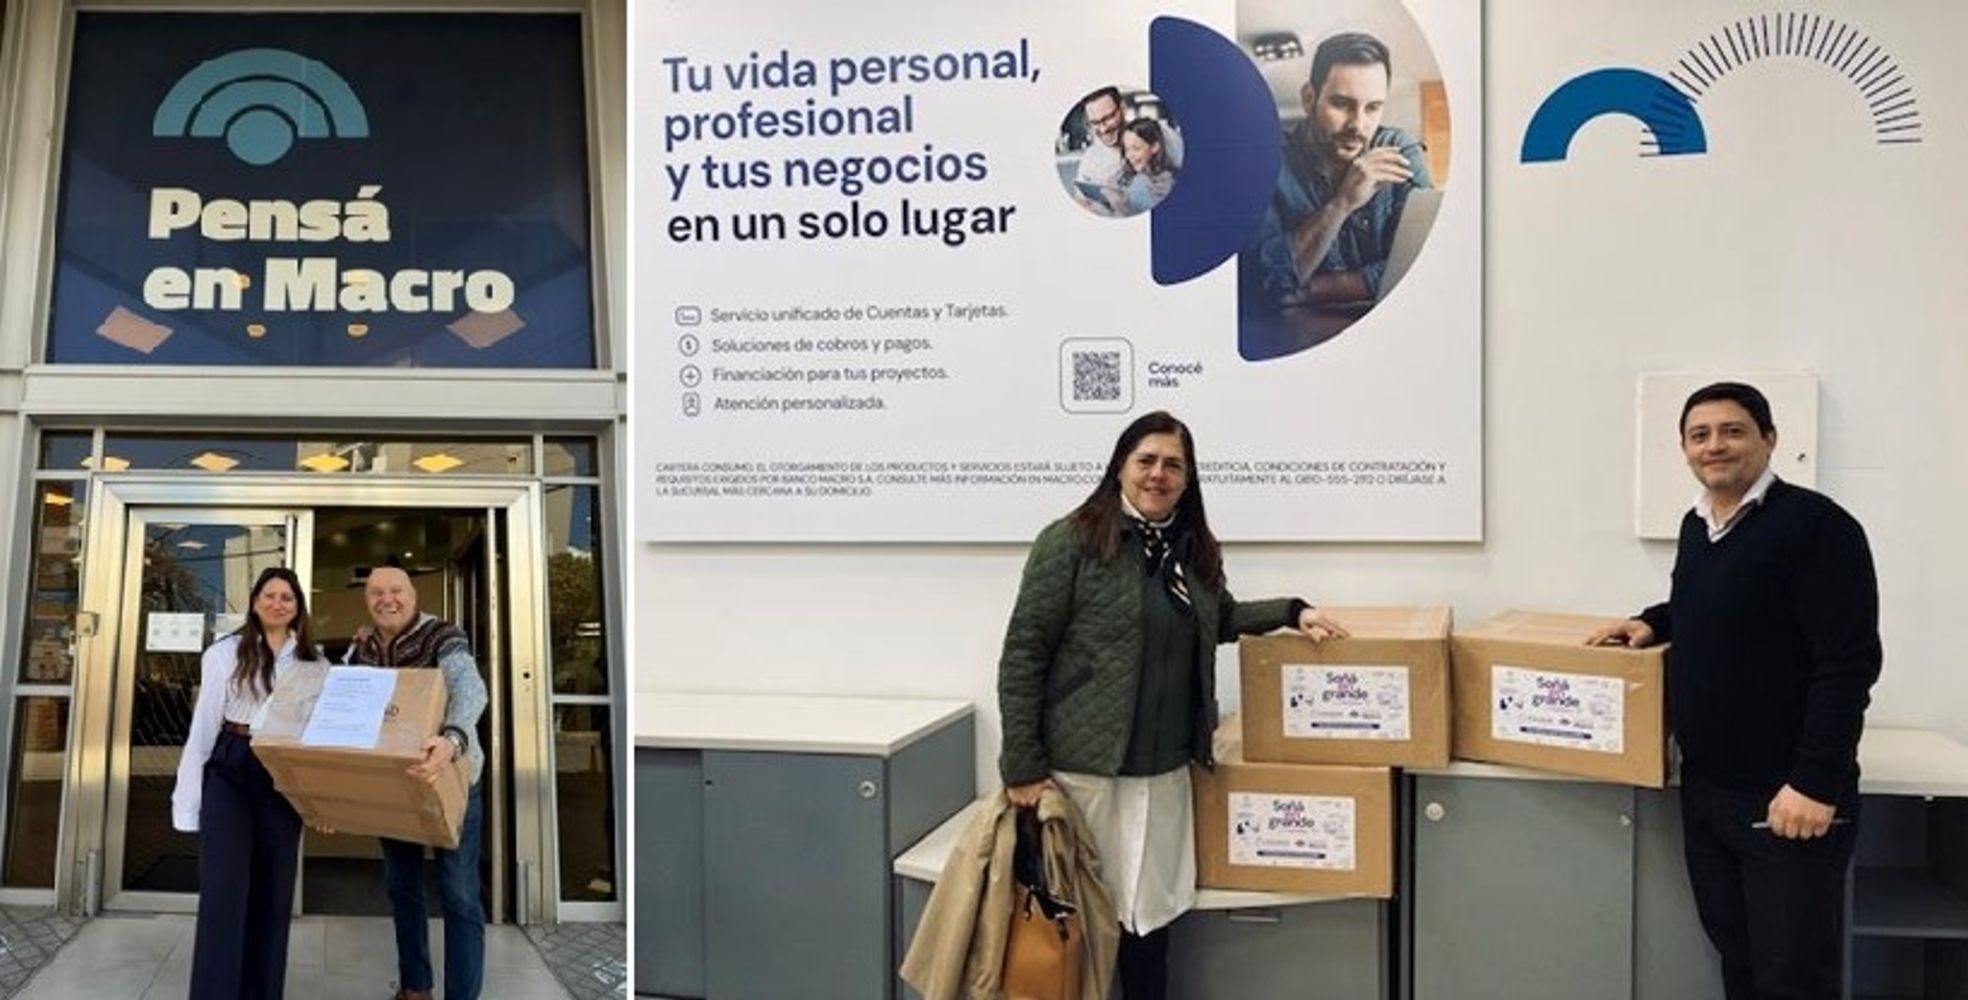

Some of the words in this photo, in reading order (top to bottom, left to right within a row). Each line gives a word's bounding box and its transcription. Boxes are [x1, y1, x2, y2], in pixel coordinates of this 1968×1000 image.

[662, 56, 712, 93] Tu
[724, 50, 817, 90] vida
[830, 38, 1041, 96] personal,
[664, 95, 913, 152] profesional
[666, 162, 691, 201] y
[702, 155, 772, 189] tus
[784, 144, 988, 196] negocios
[148, 185, 392, 242] Pensá
[667, 213, 719, 242] en
[732, 212, 786, 240] un
[798, 200, 888, 239] solo
[901, 198, 1016, 247] lugar
[143, 266, 244, 311] en
[263, 257, 515, 314] Macro
[711, 306, 769, 322] Servicio
[771, 305, 841, 321] unificado
[843, 306, 864, 321] de
[866, 304, 930, 320] Cuentas
[931, 307, 944, 321] y
[944, 302, 1009, 322] Tarjetas.
[712, 338, 791, 353] Soluciones
[794, 338, 814, 352] de
[816, 337, 868, 352] cobros
[871, 339, 882, 355] y
[884, 338, 934, 354] pagos.
[713, 366, 804, 381] Financiación
[806, 368, 842, 384] para
[843, 367, 868, 381] tus
[871, 366, 950, 384] proyectos.
[1148, 360, 1203, 374] Conocé
[1148, 375, 1179, 388] más
[714, 395, 780, 410] Atención
[782, 395, 888, 412] personalizada.
